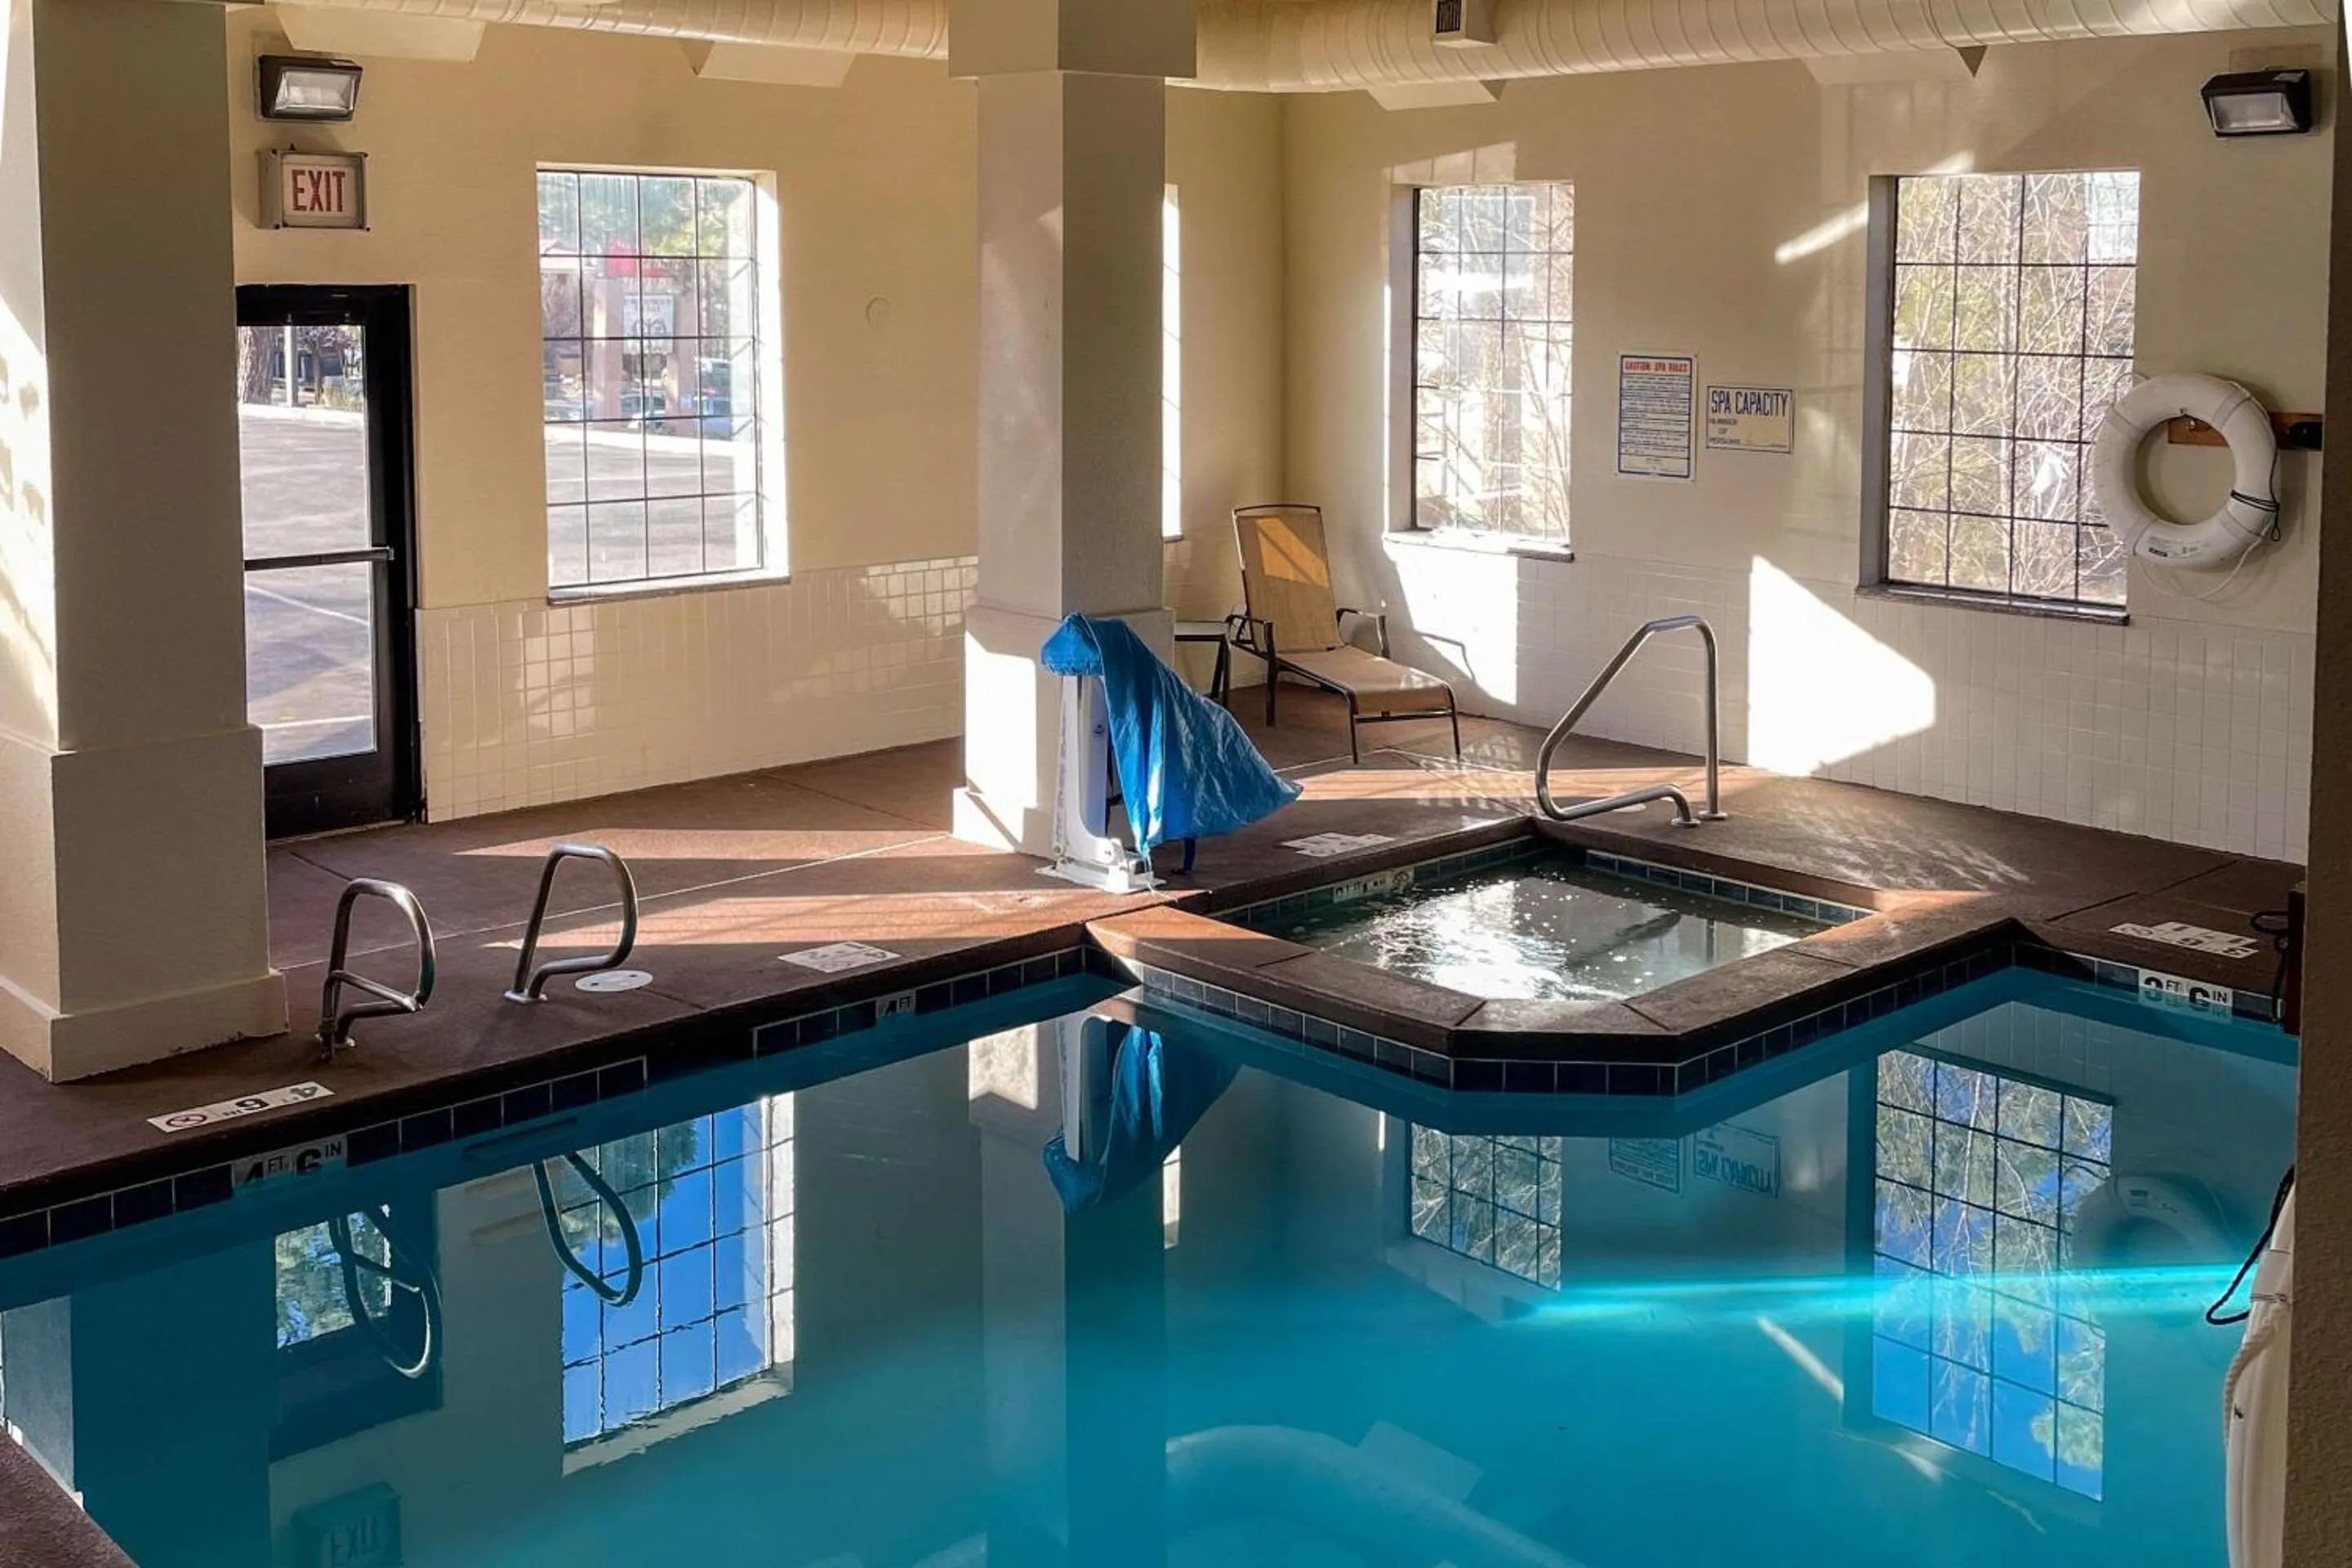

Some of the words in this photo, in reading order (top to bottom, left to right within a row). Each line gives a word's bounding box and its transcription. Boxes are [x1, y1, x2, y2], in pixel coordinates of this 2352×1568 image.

[291, 169, 345, 212] EXIT
[1711, 390, 1731, 414] SPA
[1735, 391, 1788, 417] CAPACITY
[2166, 980, 2180, 993] FT
[2212, 991, 2227, 1004] IN
[288, 1085, 318, 1099] 4
[326, 1141, 341, 1157] IN
